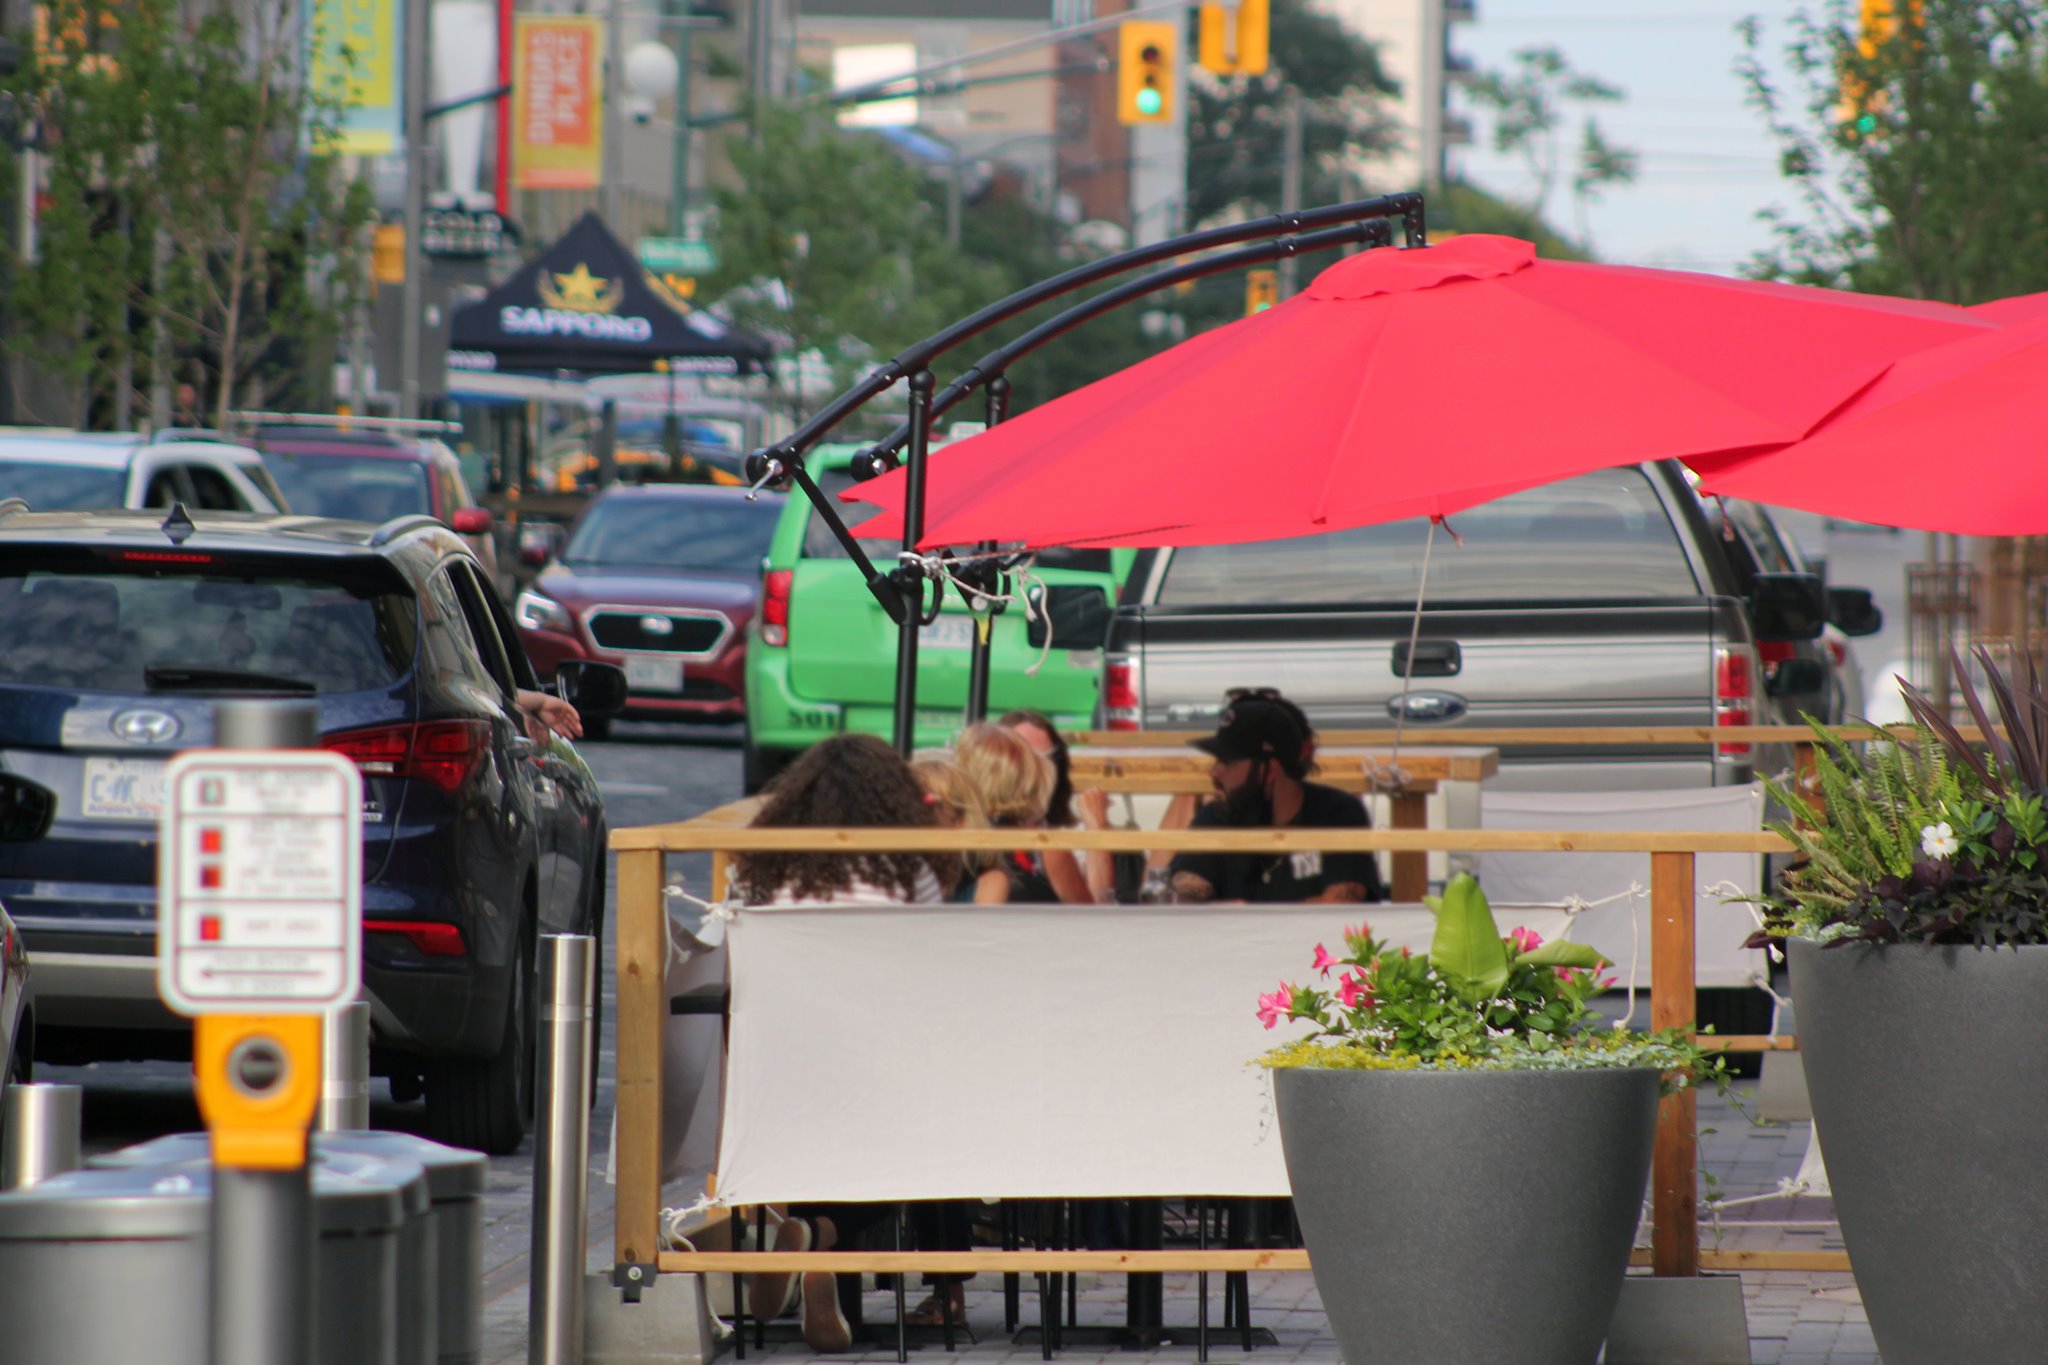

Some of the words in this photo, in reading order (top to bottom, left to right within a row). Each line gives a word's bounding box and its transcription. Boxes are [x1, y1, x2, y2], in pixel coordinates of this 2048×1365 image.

[528, 31, 554, 143] DUNDAS
[556, 31, 583, 127] PLACE
[424, 213, 501, 233] COLD
[423, 234, 498, 252] BEER
[501, 306, 652, 342] SAPPORO
